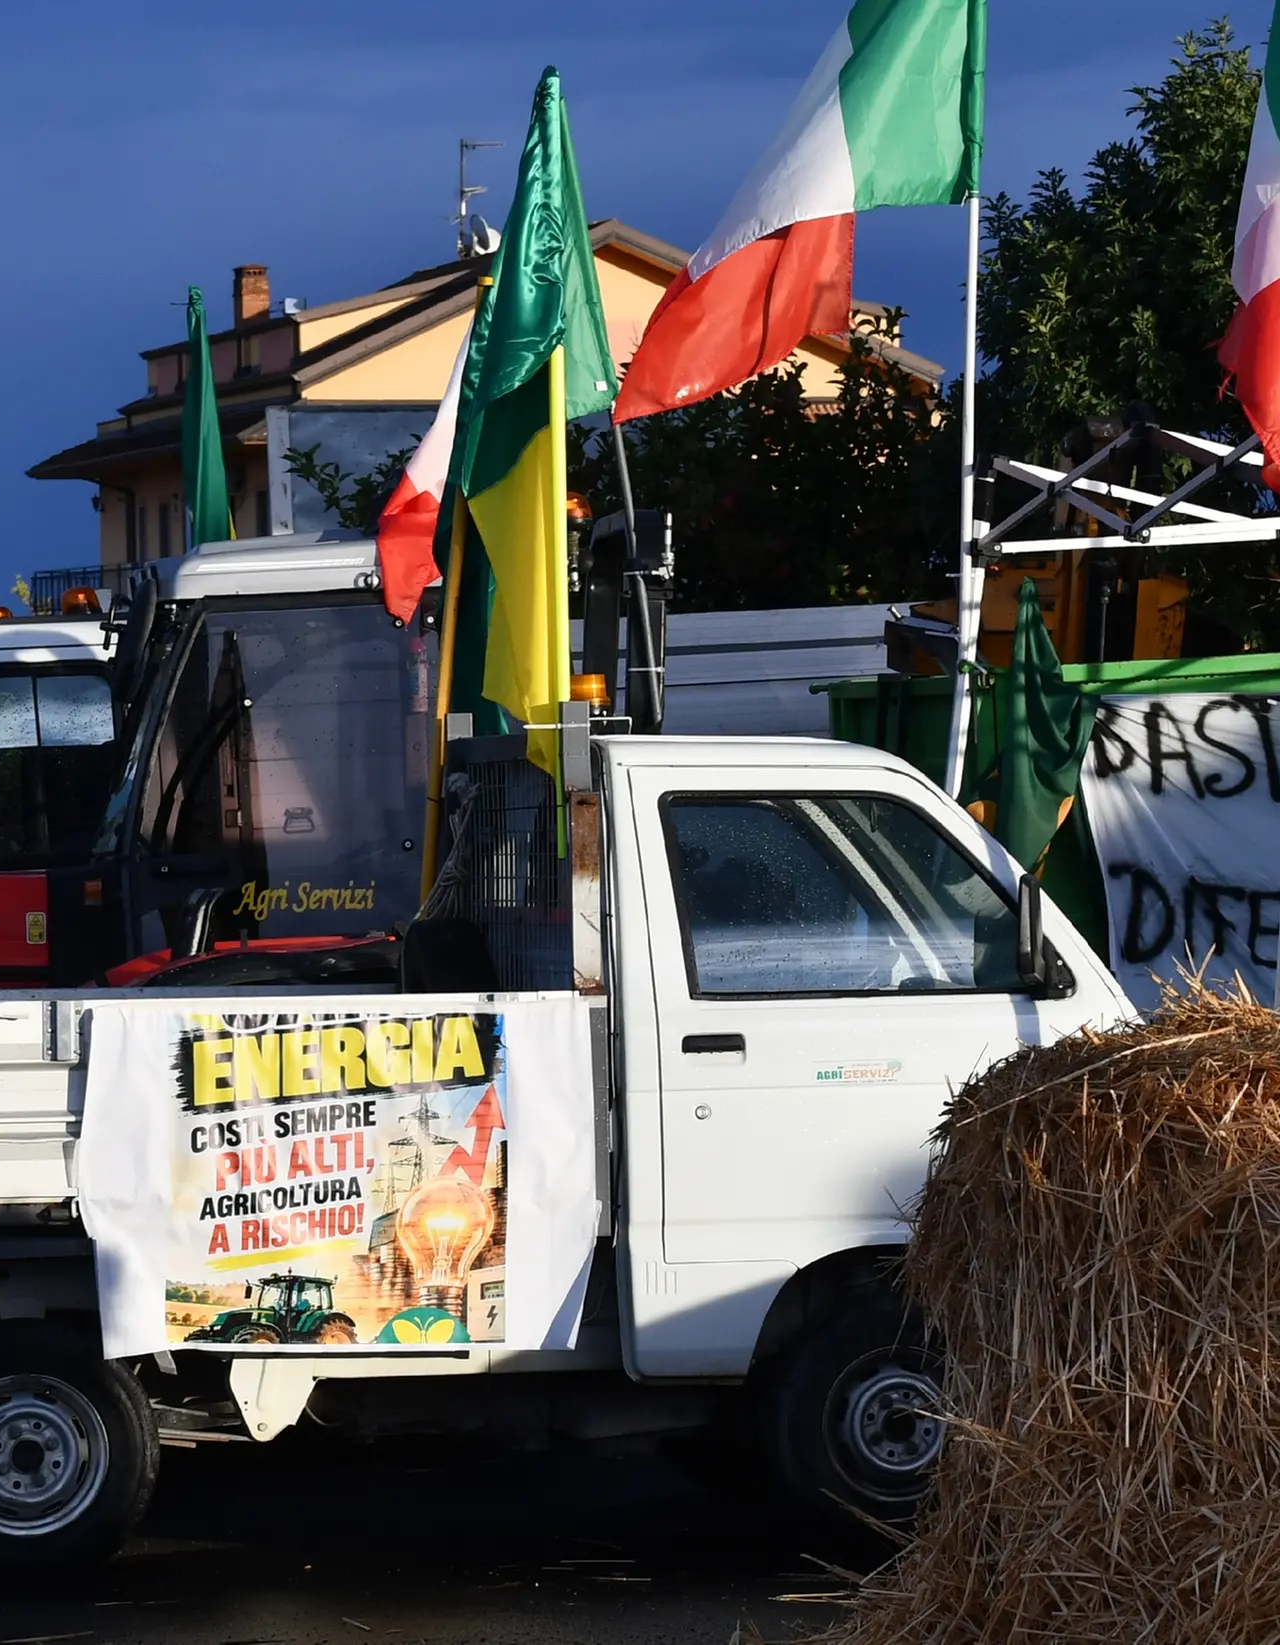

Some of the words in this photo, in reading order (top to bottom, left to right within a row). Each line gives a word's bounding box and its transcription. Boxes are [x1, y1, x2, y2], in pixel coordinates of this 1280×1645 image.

[233, 880, 290, 921] Agri
[292, 880, 376, 913] Servizi
[193, 1016, 485, 1106] ENERGIA
[191, 1116, 265, 1154] COSTI
[274, 1100, 377, 1139] SEMPRE
[215, 1138, 278, 1192] PIÙ
[287, 1131, 375, 1180] ALTI,
[199, 1176, 362, 1221] AGRICOLTURA
[208, 1223, 230, 1255] A
[241, 1203, 365, 1251] RISCHIO!
